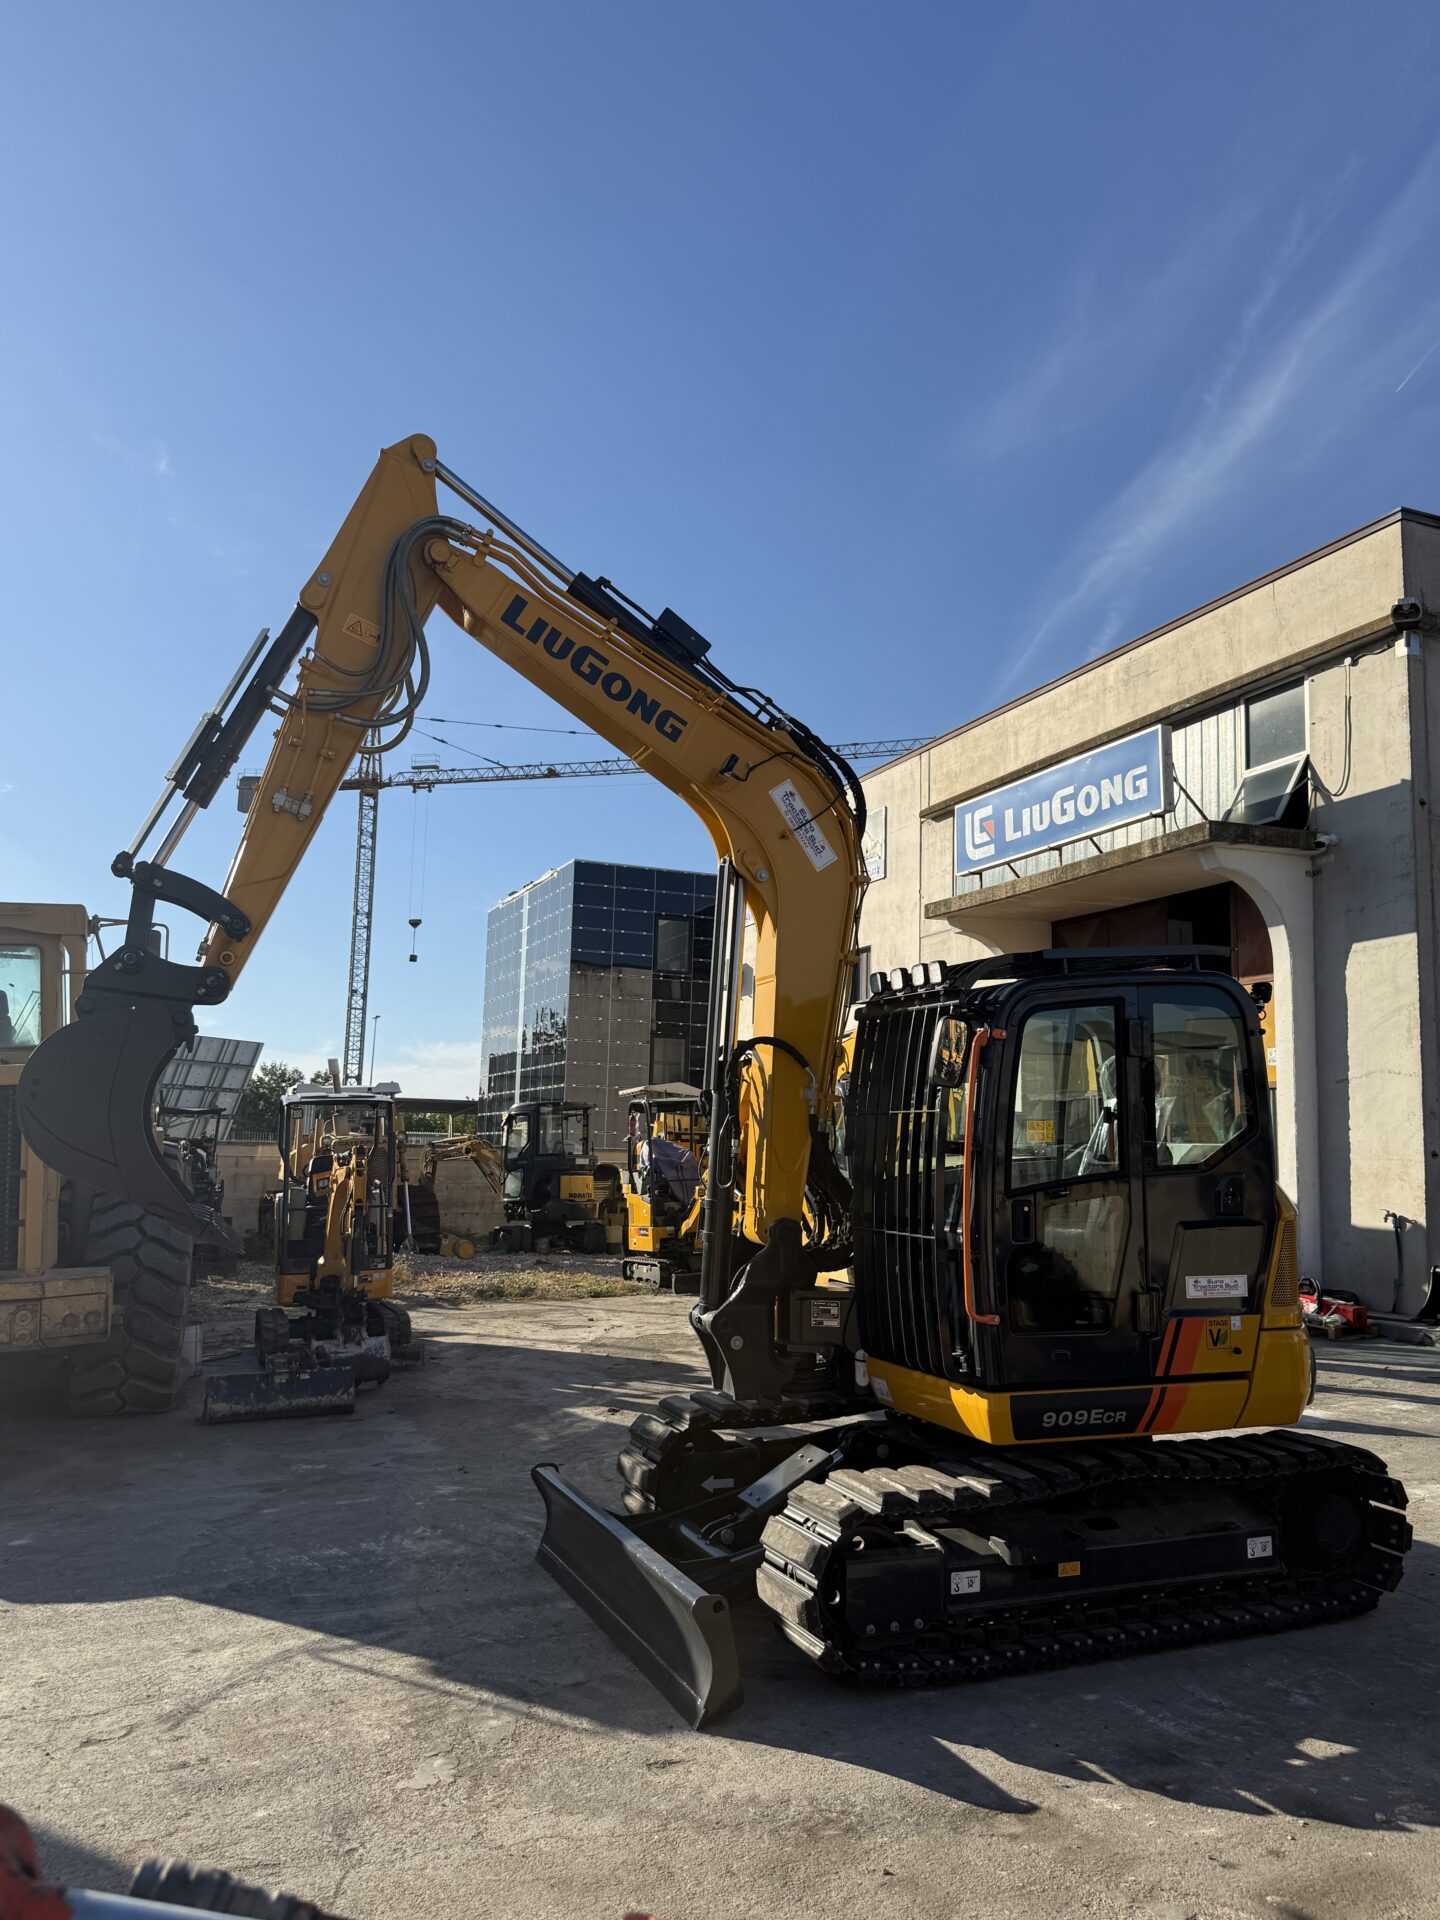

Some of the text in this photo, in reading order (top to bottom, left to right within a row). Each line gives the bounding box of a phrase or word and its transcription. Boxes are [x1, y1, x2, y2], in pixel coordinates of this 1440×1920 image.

[799, 808, 815, 833] Euro
[808, 835, 823, 855] Sud
[1208, 1319, 1229, 1327] STAGE
[1208, 1328, 1221, 1347] V
[1041, 1408, 1127, 1428] 909ECR
